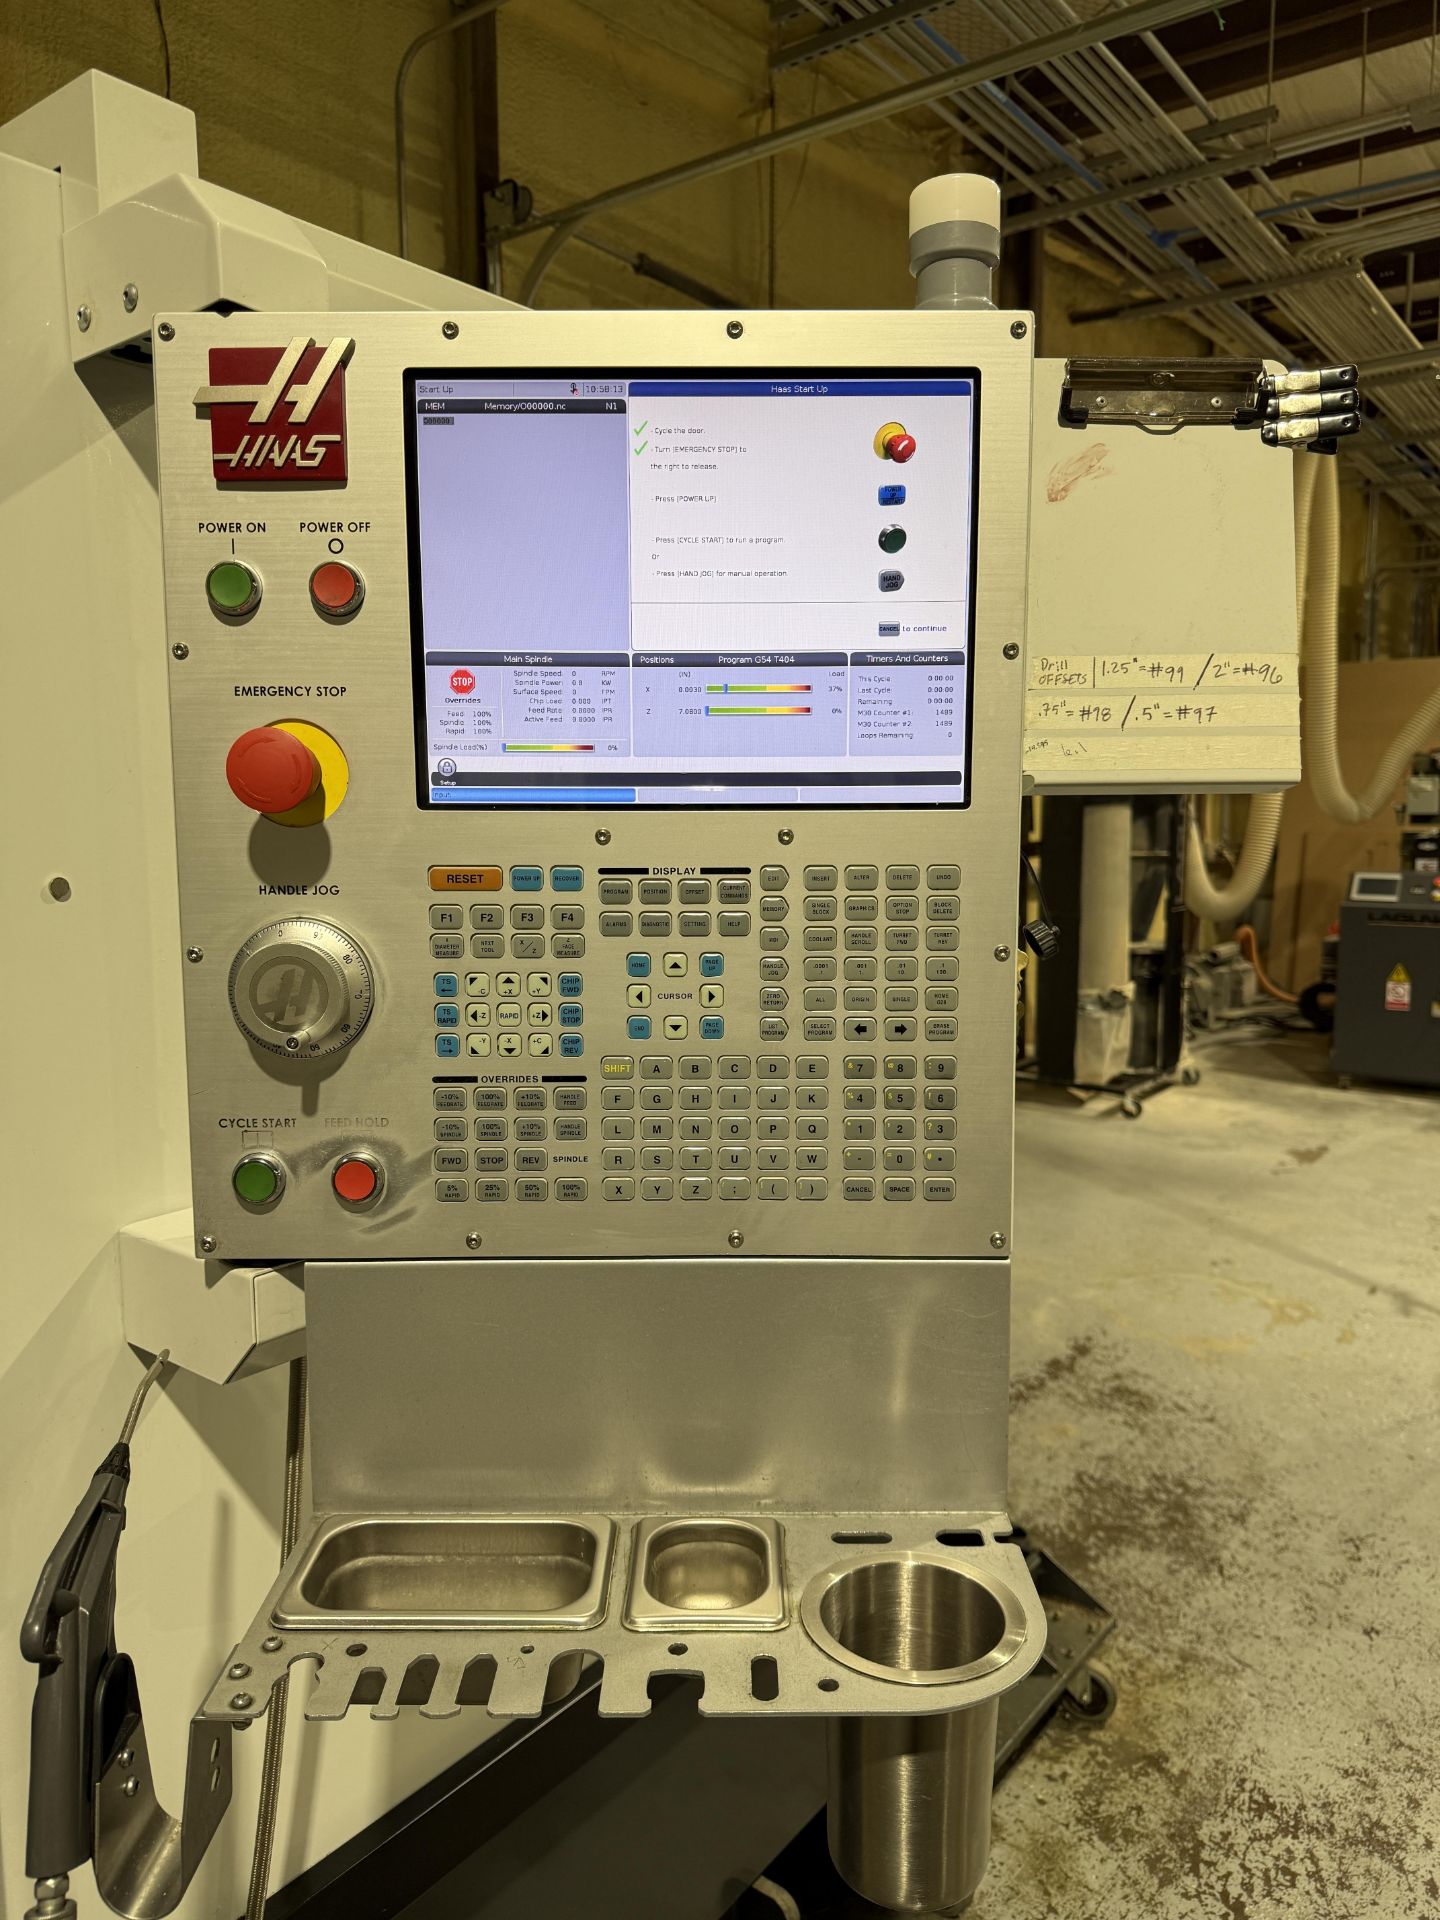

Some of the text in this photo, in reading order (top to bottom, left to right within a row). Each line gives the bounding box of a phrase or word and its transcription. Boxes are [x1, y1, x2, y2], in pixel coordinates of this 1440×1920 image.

[419, 385, 454, 395] Start Up
[586, 385, 623, 393] 10:58:13
[771, 385, 829, 395] Haas Start Up
[425, 402, 445, 410] MEM
[605, 402, 618, 410] N1
[654, 427, 706, 436] Cycle the door.
[654, 446, 671, 454] Turn
[739, 446, 747, 454] to
[664, 463, 680, 472] right
[655, 495, 675, 503] Press
[198, 522, 266, 533] POWER ON
[299, 522, 371, 533] POWER OFF
[655, 536, 675, 544] Press
[656, 570, 675, 578] Press
[883, 574, 901, 582] HAND
[885, 581, 899, 589] JOG
[913, 624, 947, 632] continue
[503, 655, 553, 664] Main Spindle
[640, 656, 674, 664] Positions
[718, 655, 795, 665] Program G54 T404
[866, 654, 949, 663] Timers And Counters
[1041, 659, 1069, 672] Drill
[452, 676, 473, 687] STOP
[1038, 673, 1087, 686] OFFSETS
[234, 686, 347, 697] EMERGENCY STOP
[652, 867, 696, 875] DISPLAY
[447, 874, 484, 884] RESET
[259, 885, 340, 895] HANDLE JOG
[440, 913, 453, 923] F1
[480, 913, 494, 922] F2
[521, 913, 534, 922] F3
[561, 913, 574, 922] F4
[604, 1064, 631, 1073] SHIFT
[652, 1065, 661, 1074] A
[691, 1064, 699, 1073] B
[731, 1064, 739, 1073] C
[769, 1064, 777, 1073] D
[809, 1064, 816, 1073] E
[856, 1064, 864, 1073] 7
[897, 1064, 904, 1073] 8
[938, 1064, 944, 1073] 9
[481, 1075, 539, 1083] OVERRIDES
[614, 1095, 622, 1104] F
[653, 1094, 661, 1104] G
[692, 1094, 700, 1103] H
[770, 1094, 777, 1103] J
[808, 1094, 816, 1103] K
[856, 1094, 863, 1103] 4
[897, 1094, 903, 1103] 5
[937, 1094, 944, 1103] 6
[218, 1118, 297, 1129] CYCLE START
[324, 1117, 389, 1128] FEED HOLD
[614, 1125, 622, 1134] L
[652, 1125, 662, 1134] M
[692, 1125, 700, 1134] N
[730, 1124, 739, 1134] O
[770, 1125, 777, 1134] P
[808, 1125, 817, 1134] Q
[858, 1125, 862, 1133] 1
[896, 1125, 903, 1133] 2
[937, 1124, 944, 1133] 3
[442, 1157, 462, 1165] FWD
[480, 1157, 504, 1165] STOP
[522, 1156, 540, 1164] REV
[614, 1155, 622, 1165] R
[653, 1155, 661, 1164] S
[692, 1155, 700, 1164] T
[731, 1155, 738, 1164] U
[769, 1155, 777, 1163] V
[807, 1155, 817, 1164] W
[896, 1155, 903, 1164] 0
[447, 1184, 458, 1192] 5%
[615, 1186, 623, 1195] X
[654, 1185, 661, 1194] Y
[692, 1185, 700, 1194] Z
